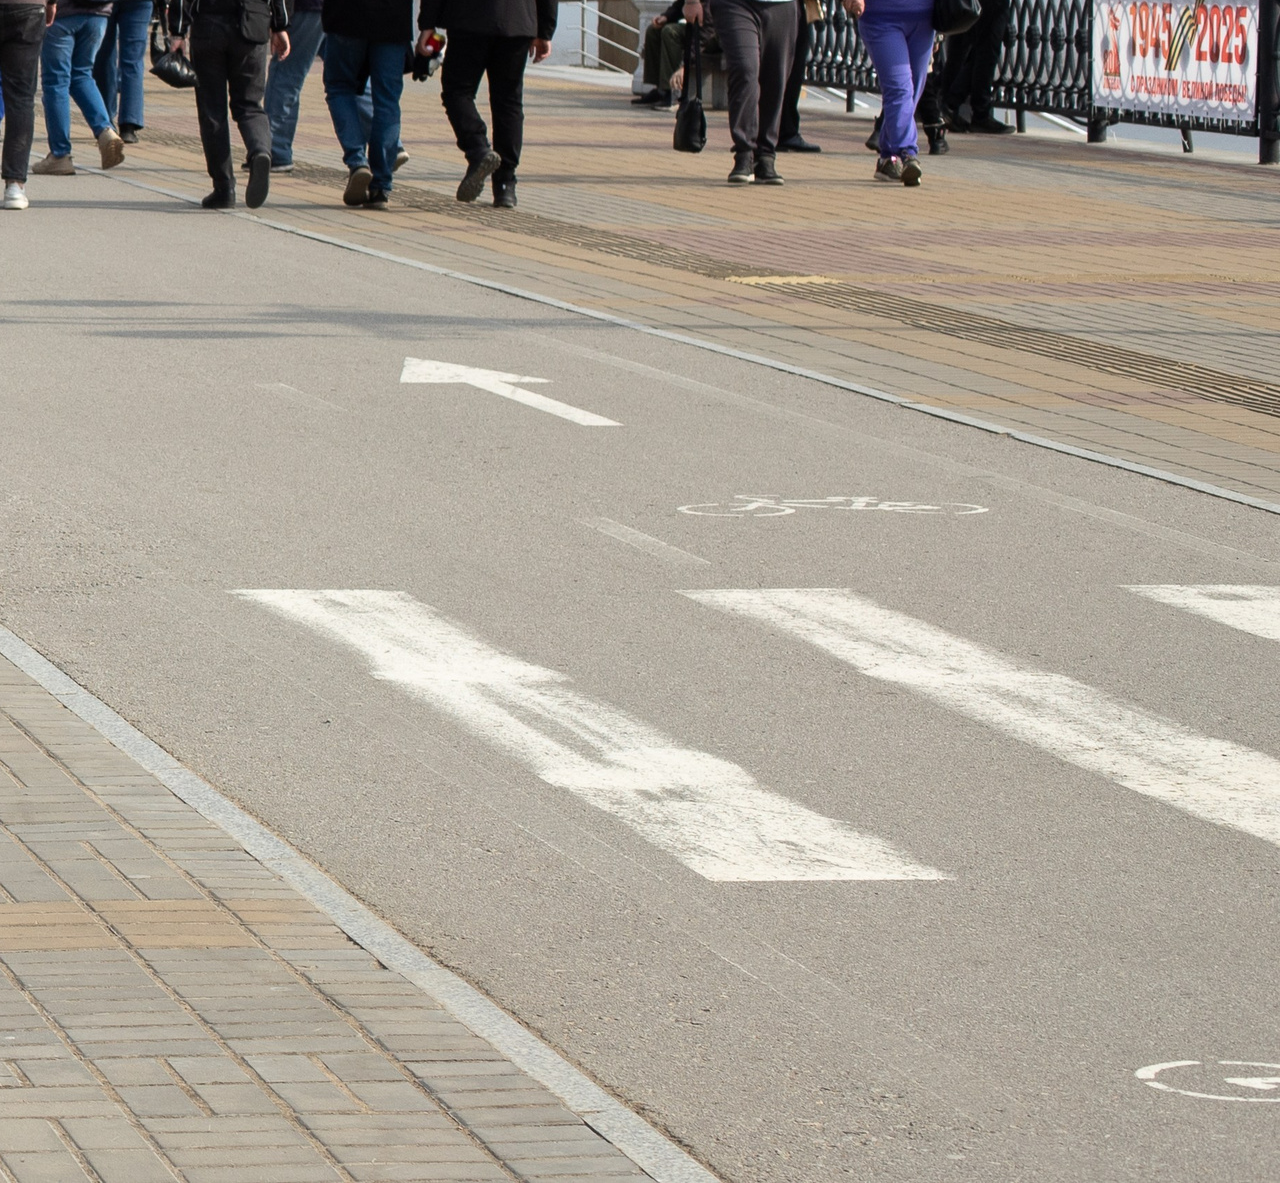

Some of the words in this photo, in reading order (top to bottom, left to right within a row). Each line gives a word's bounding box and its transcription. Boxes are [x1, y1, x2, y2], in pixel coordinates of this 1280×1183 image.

[1129, 0, 1173, 60] 1945
[1195, 4, 1248, 65] 2025
[1130, 74, 1135, 93] С
[1136, 75, 1179, 97] ПРАЗДНИКОМ
[1182, 80, 1213, 100] ВЕЛИКОЙ
